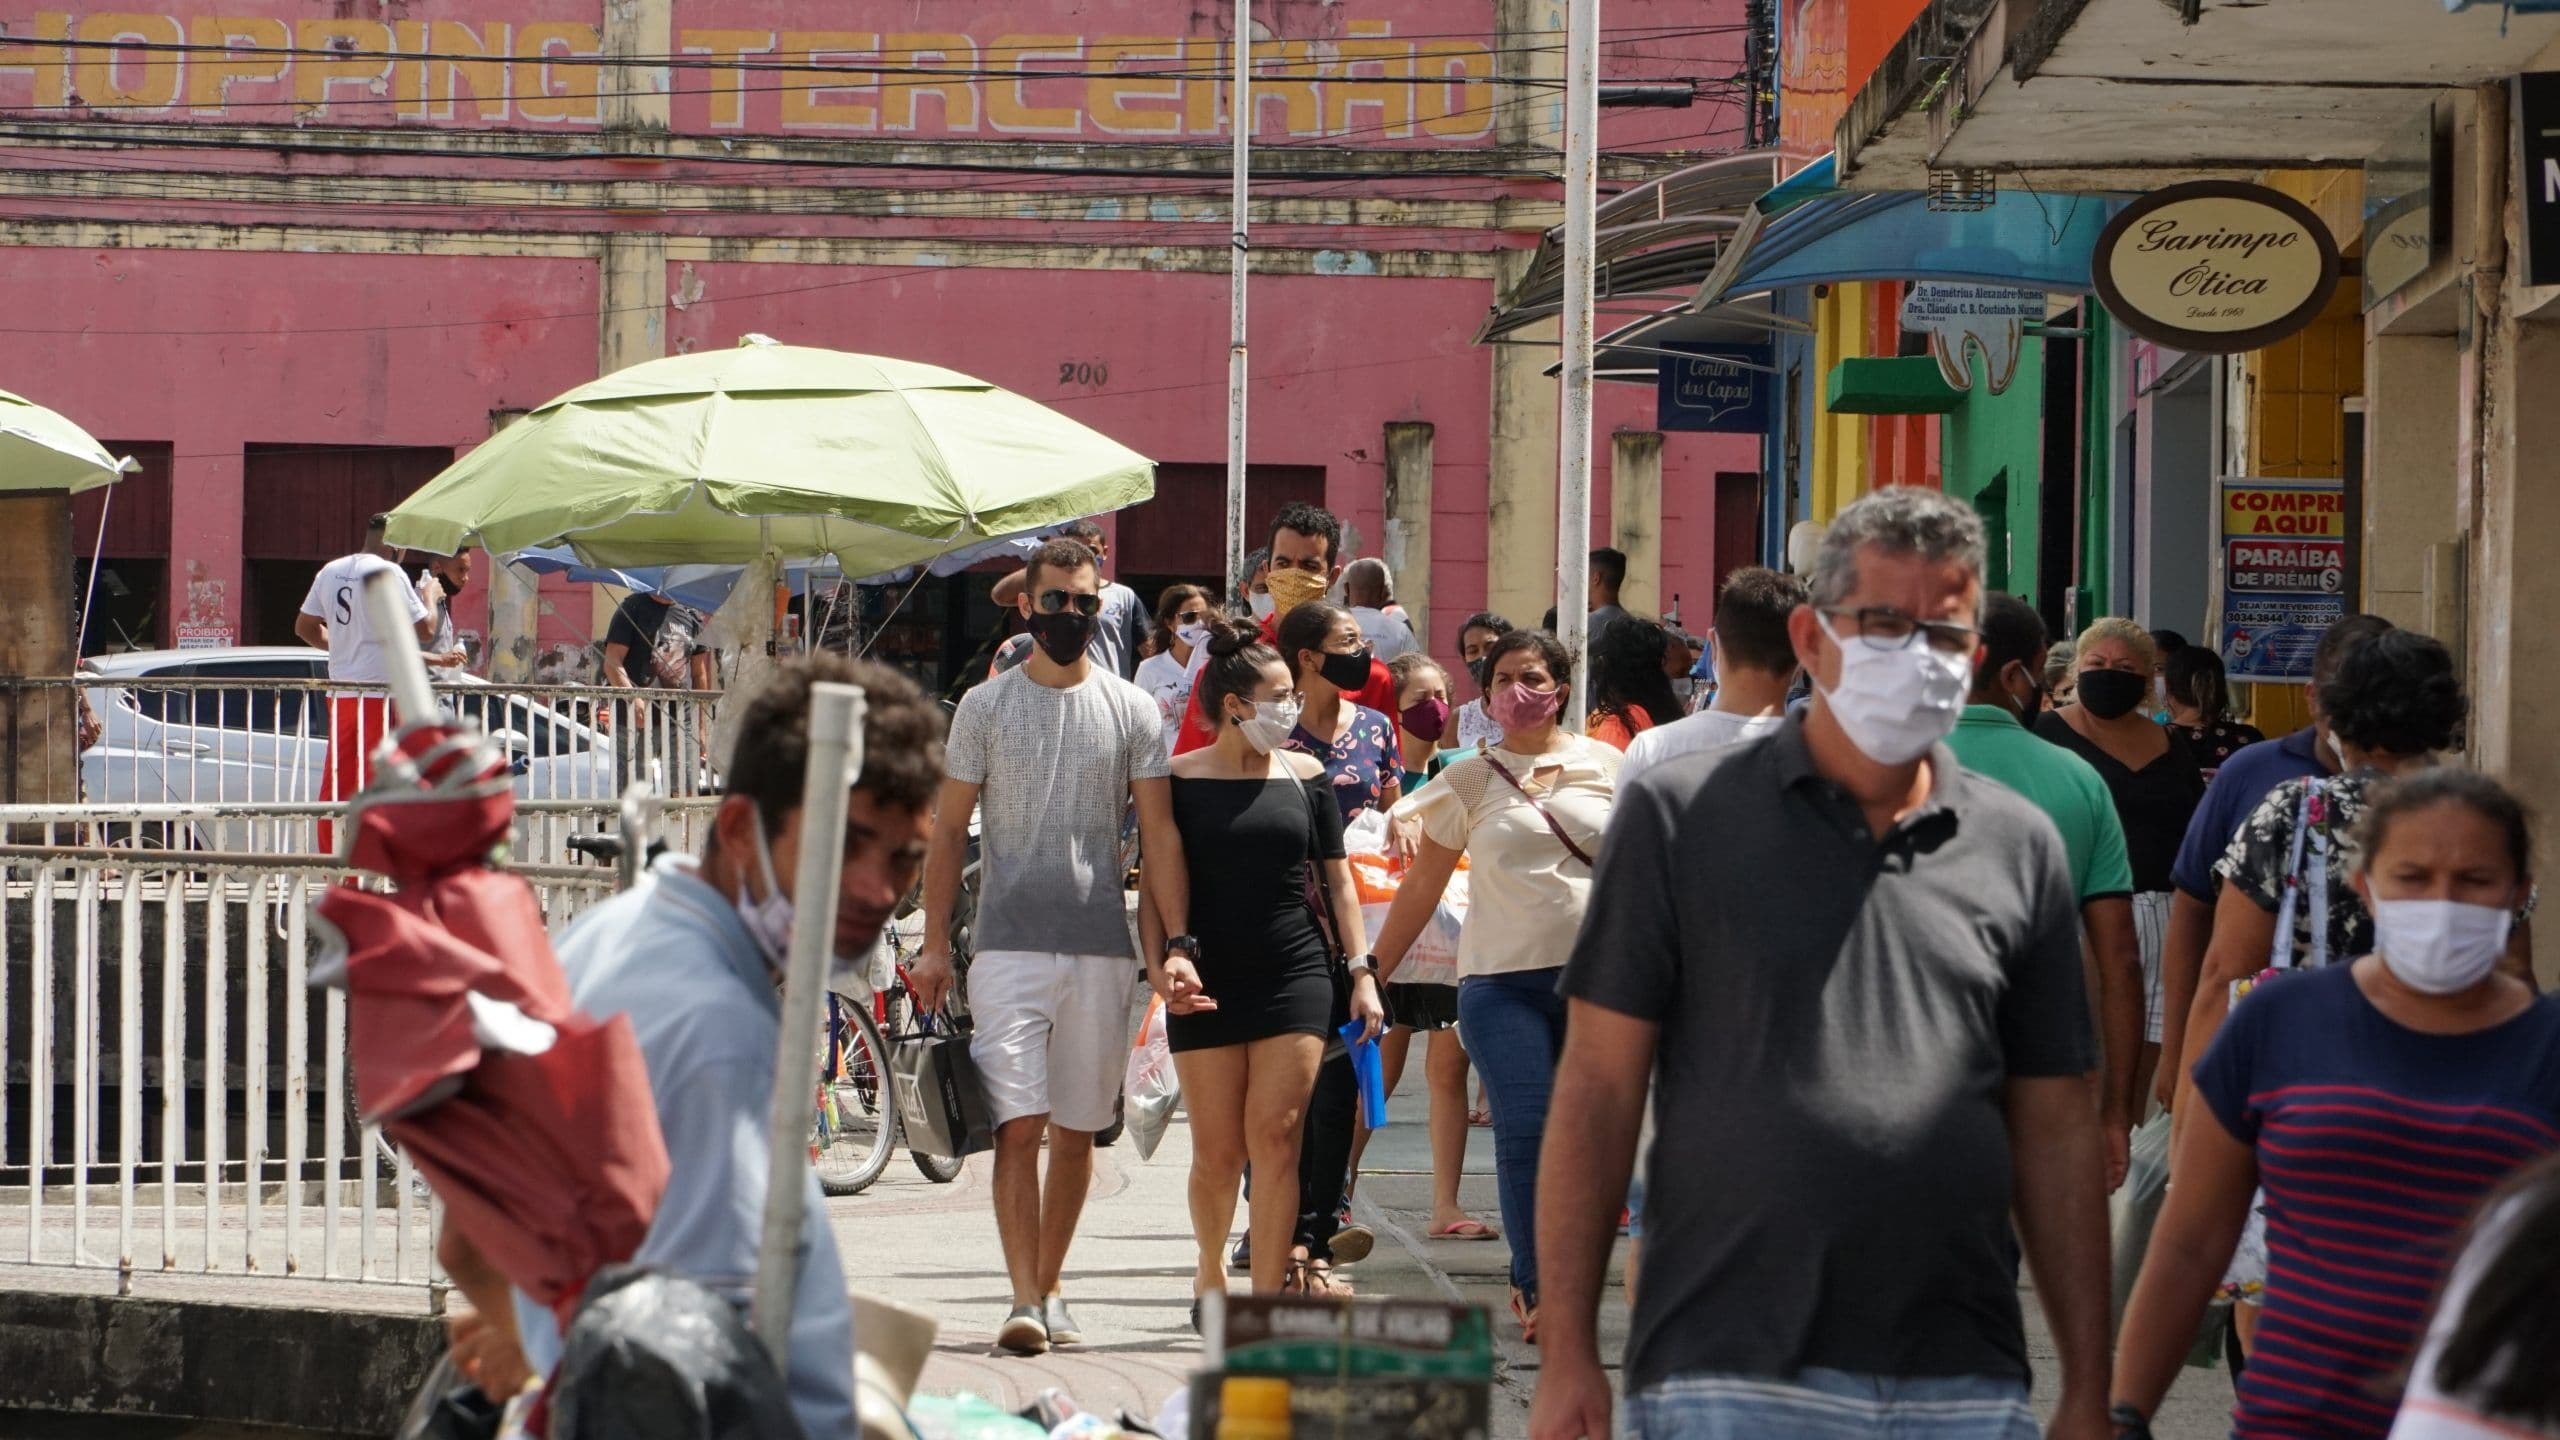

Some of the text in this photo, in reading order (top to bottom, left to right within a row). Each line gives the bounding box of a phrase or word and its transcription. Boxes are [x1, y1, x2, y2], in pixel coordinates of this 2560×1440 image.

[0, 12, 1498, 141] HOPPING TERCEIRÃO
[2137, 219, 2298, 258] Garimpo
[2169, 259, 2268, 297] Ótica
[1917, 286, 2043, 300] Dr. Demétrius Alexandre Nunes
[1907, 302, 1924, 314] Dra.
[1959, 303, 1968, 315] C.
[1978, 303, 2016, 316] Coutinho
[2017, 304, 2043, 316] Nunes
[2186, 306, 2218, 318] Desde
[1059, 362, 1108, 385] 200
[1706, 379, 1750, 403] Capas
[2253, 514, 2328, 535] AQUI
[2235, 544, 2342, 567] PARAÍBA
[2235, 572, 2259, 586] DE
[336, 586, 353, 626] S
[2239, 602, 2339, 611] SEJA UM REVENDEDOR
[2227, 612, 2283, 623] 3034-3844
[180, 627, 229, 637] PROIBIDO
